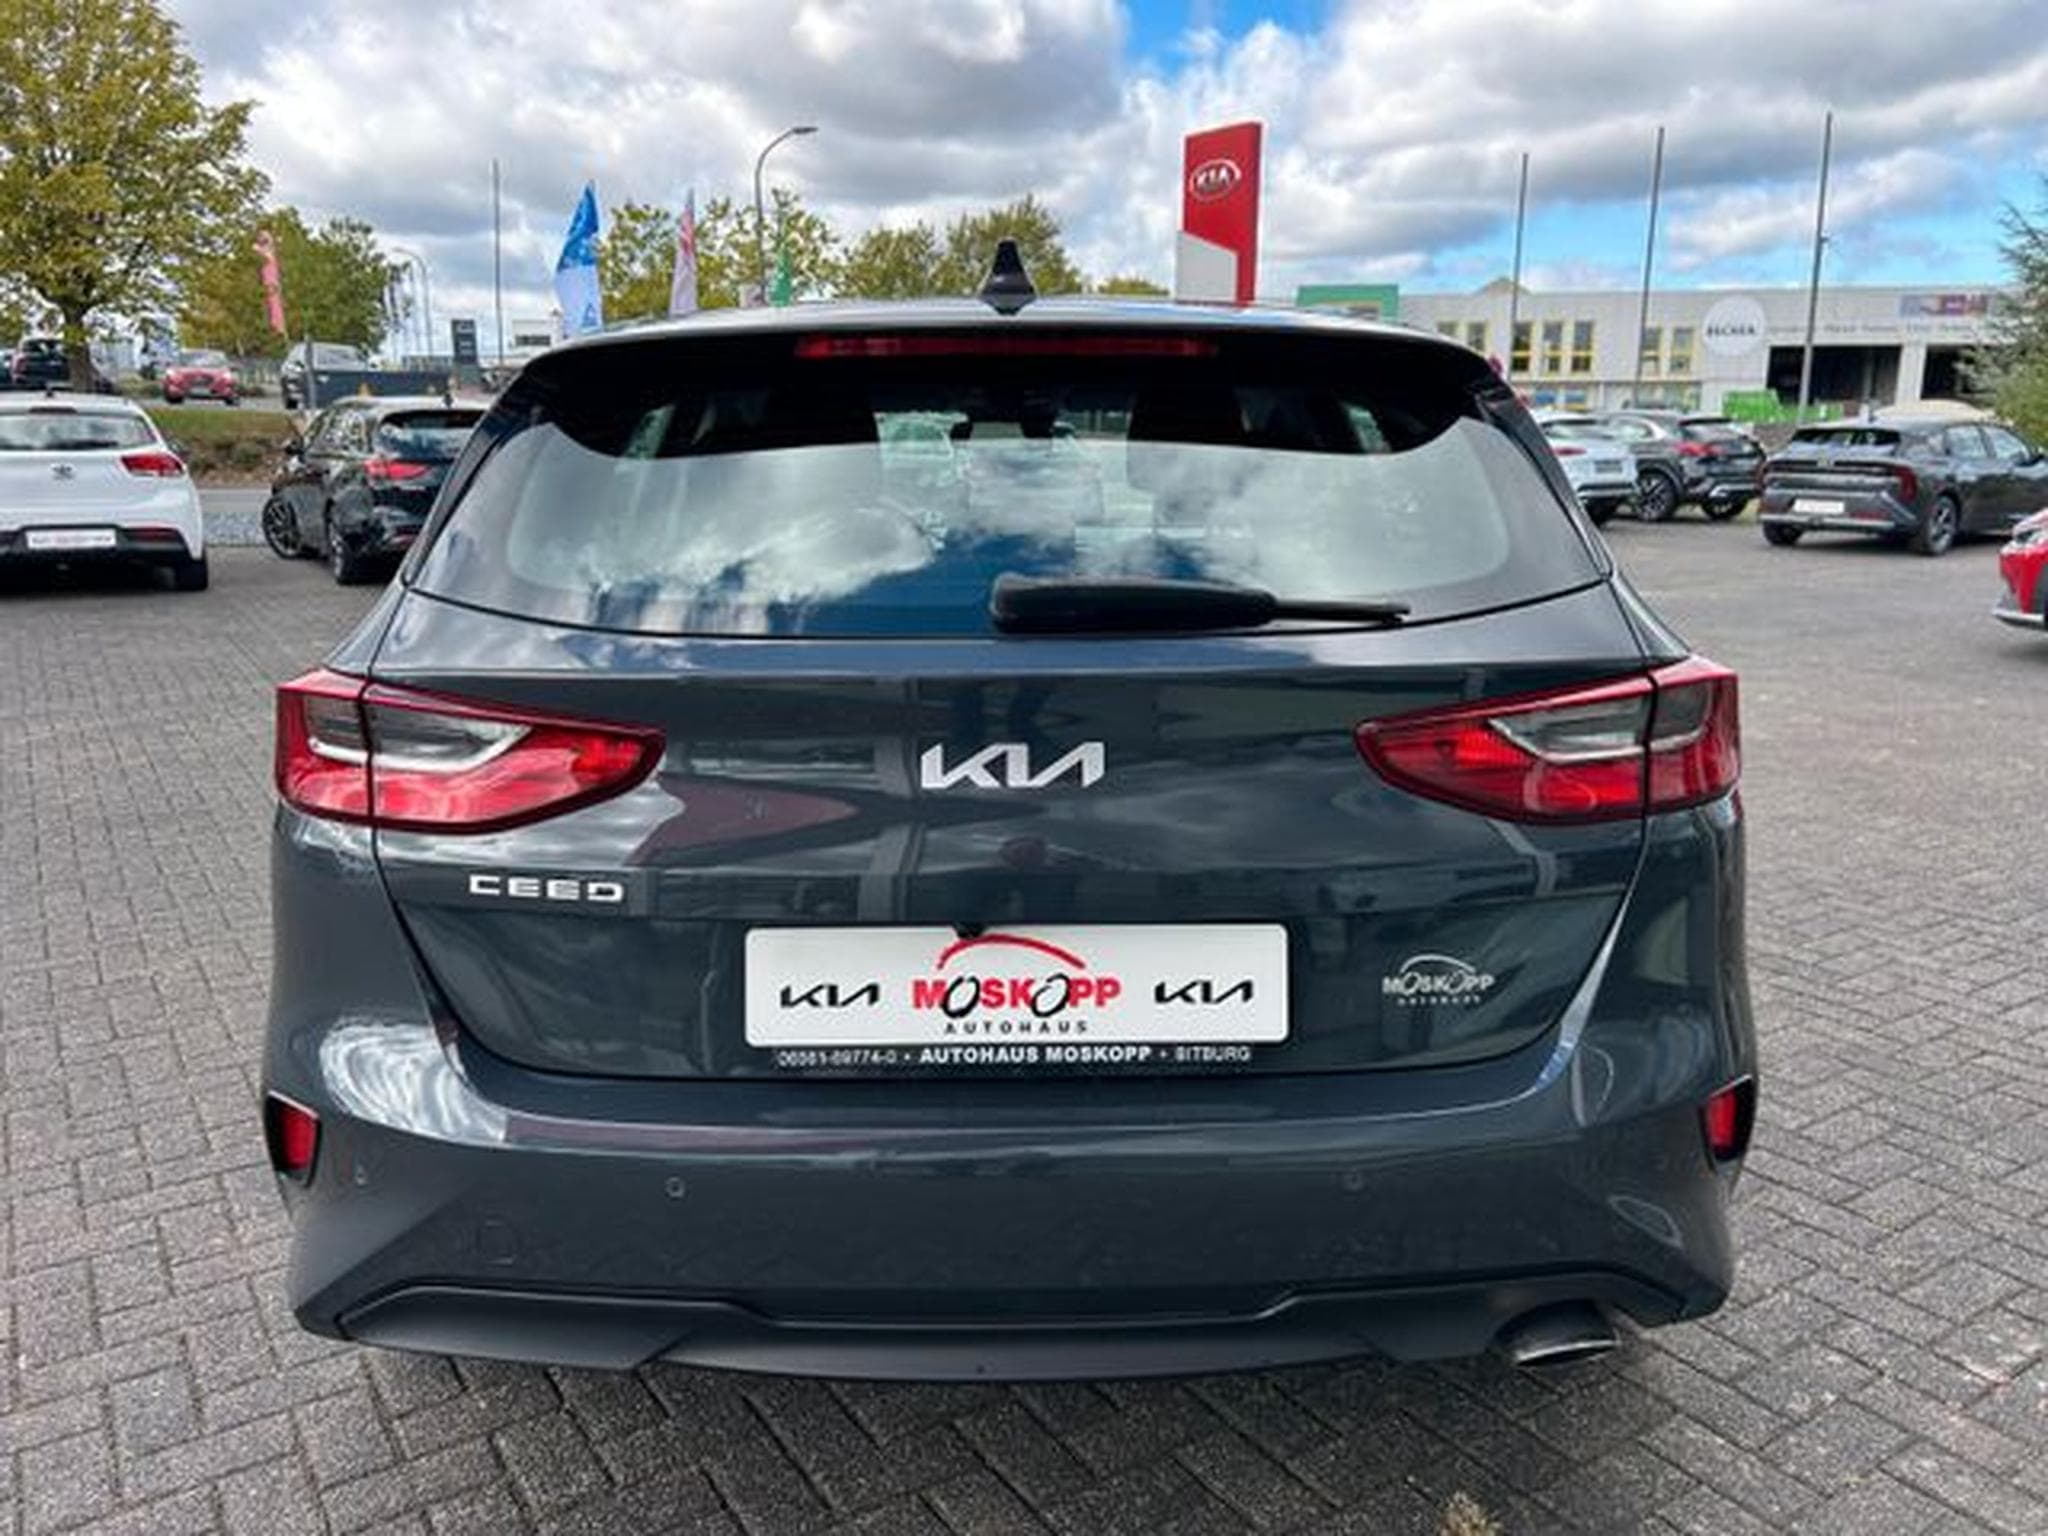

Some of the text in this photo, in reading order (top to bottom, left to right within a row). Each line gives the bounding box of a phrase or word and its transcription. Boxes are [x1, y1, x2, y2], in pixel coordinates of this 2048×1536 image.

[921, 742, 1105, 789] KIA
[469, 874, 624, 903] CEED
[780, 981, 880, 1009] KIA
[913, 972, 1121, 1018] MOSKOPP
[1154, 979, 1254, 1005] KIA
[1382, 970, 1495, 995] MOSKOPP
[944, 1020, 1088, 1035] AUTOHAUS
[918, 1046, 1039, 1065] AUTOHAUS
[1045, 1045, 1152, 1063] MOSKOPP
[1173, 1046, 1251, 1062] BITBURG
